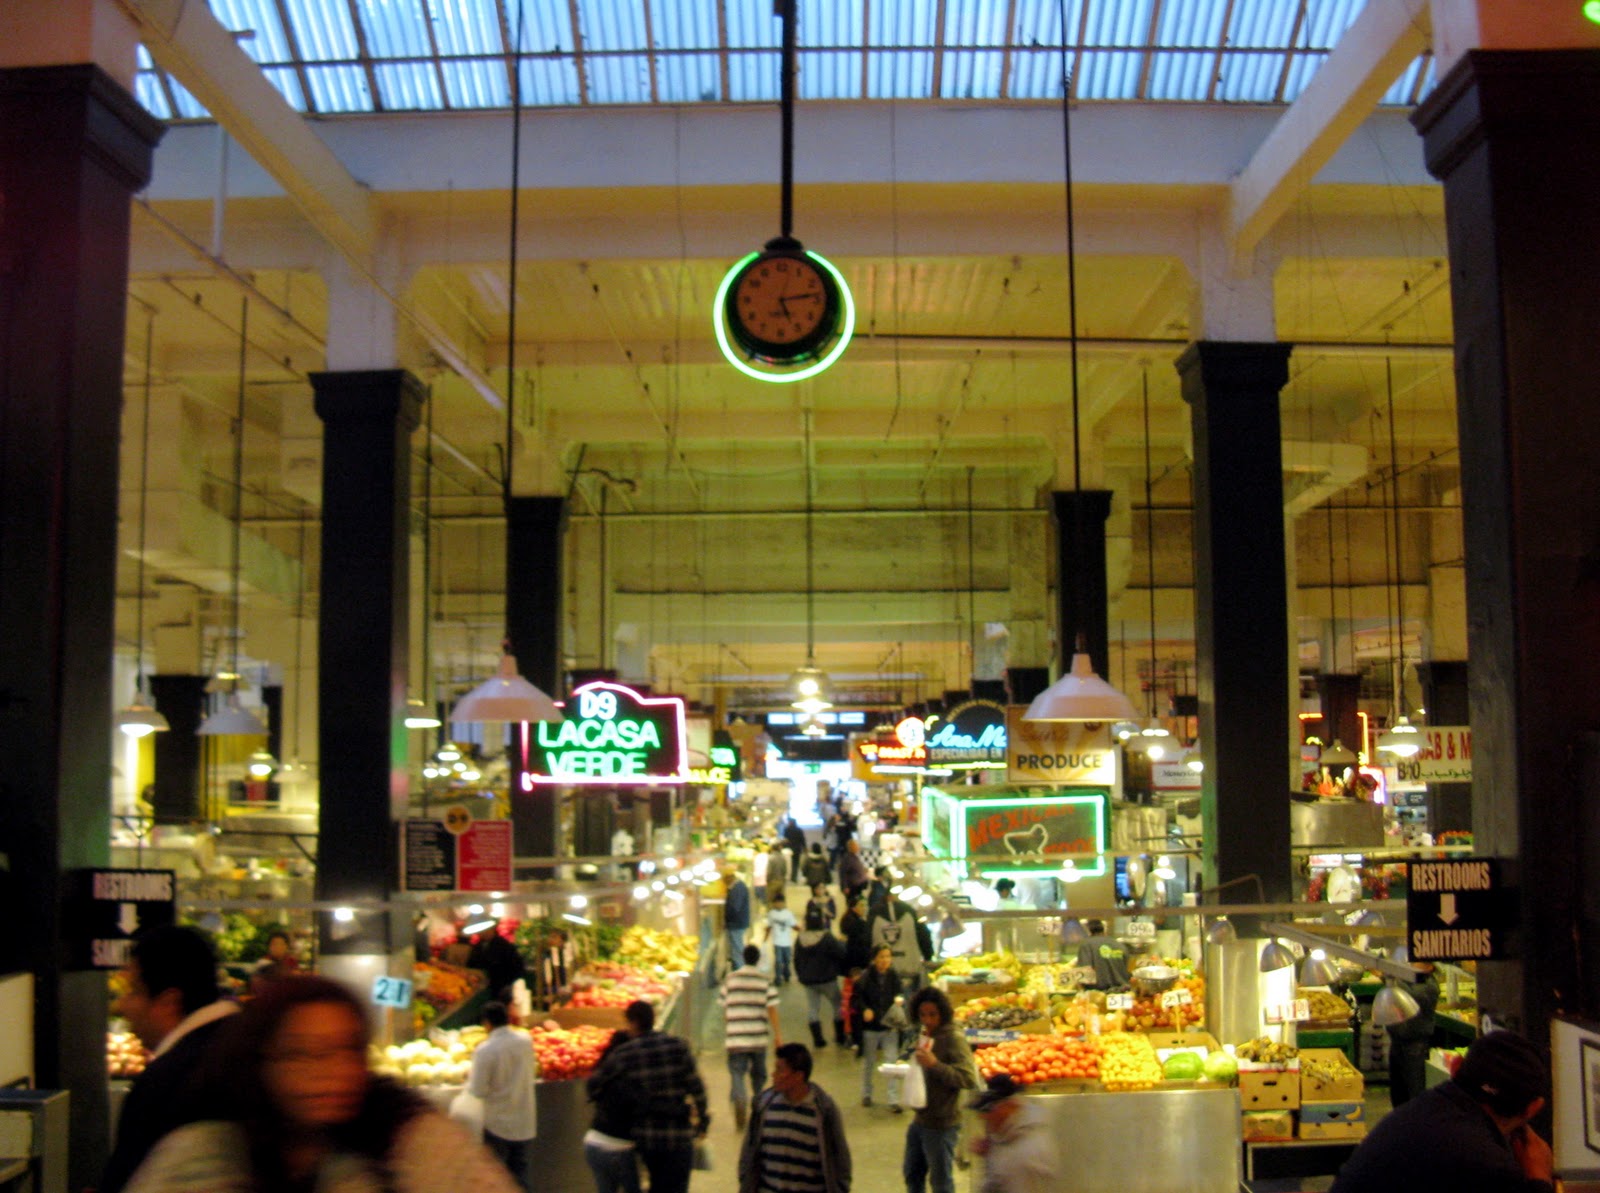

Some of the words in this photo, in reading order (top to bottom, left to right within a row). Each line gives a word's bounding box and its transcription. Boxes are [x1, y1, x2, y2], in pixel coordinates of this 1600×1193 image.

[579, 690, 618, 720] D9
[546, 751, 649, 778] VERDE
[1016, 754, 1104, 769] PRODUCE
[967, 803, 1076, 854] MEXICAN
[1411, 861, 1491, 892] RESTROOMS
[1412, 928, 1492, 959] SANITARIOS
